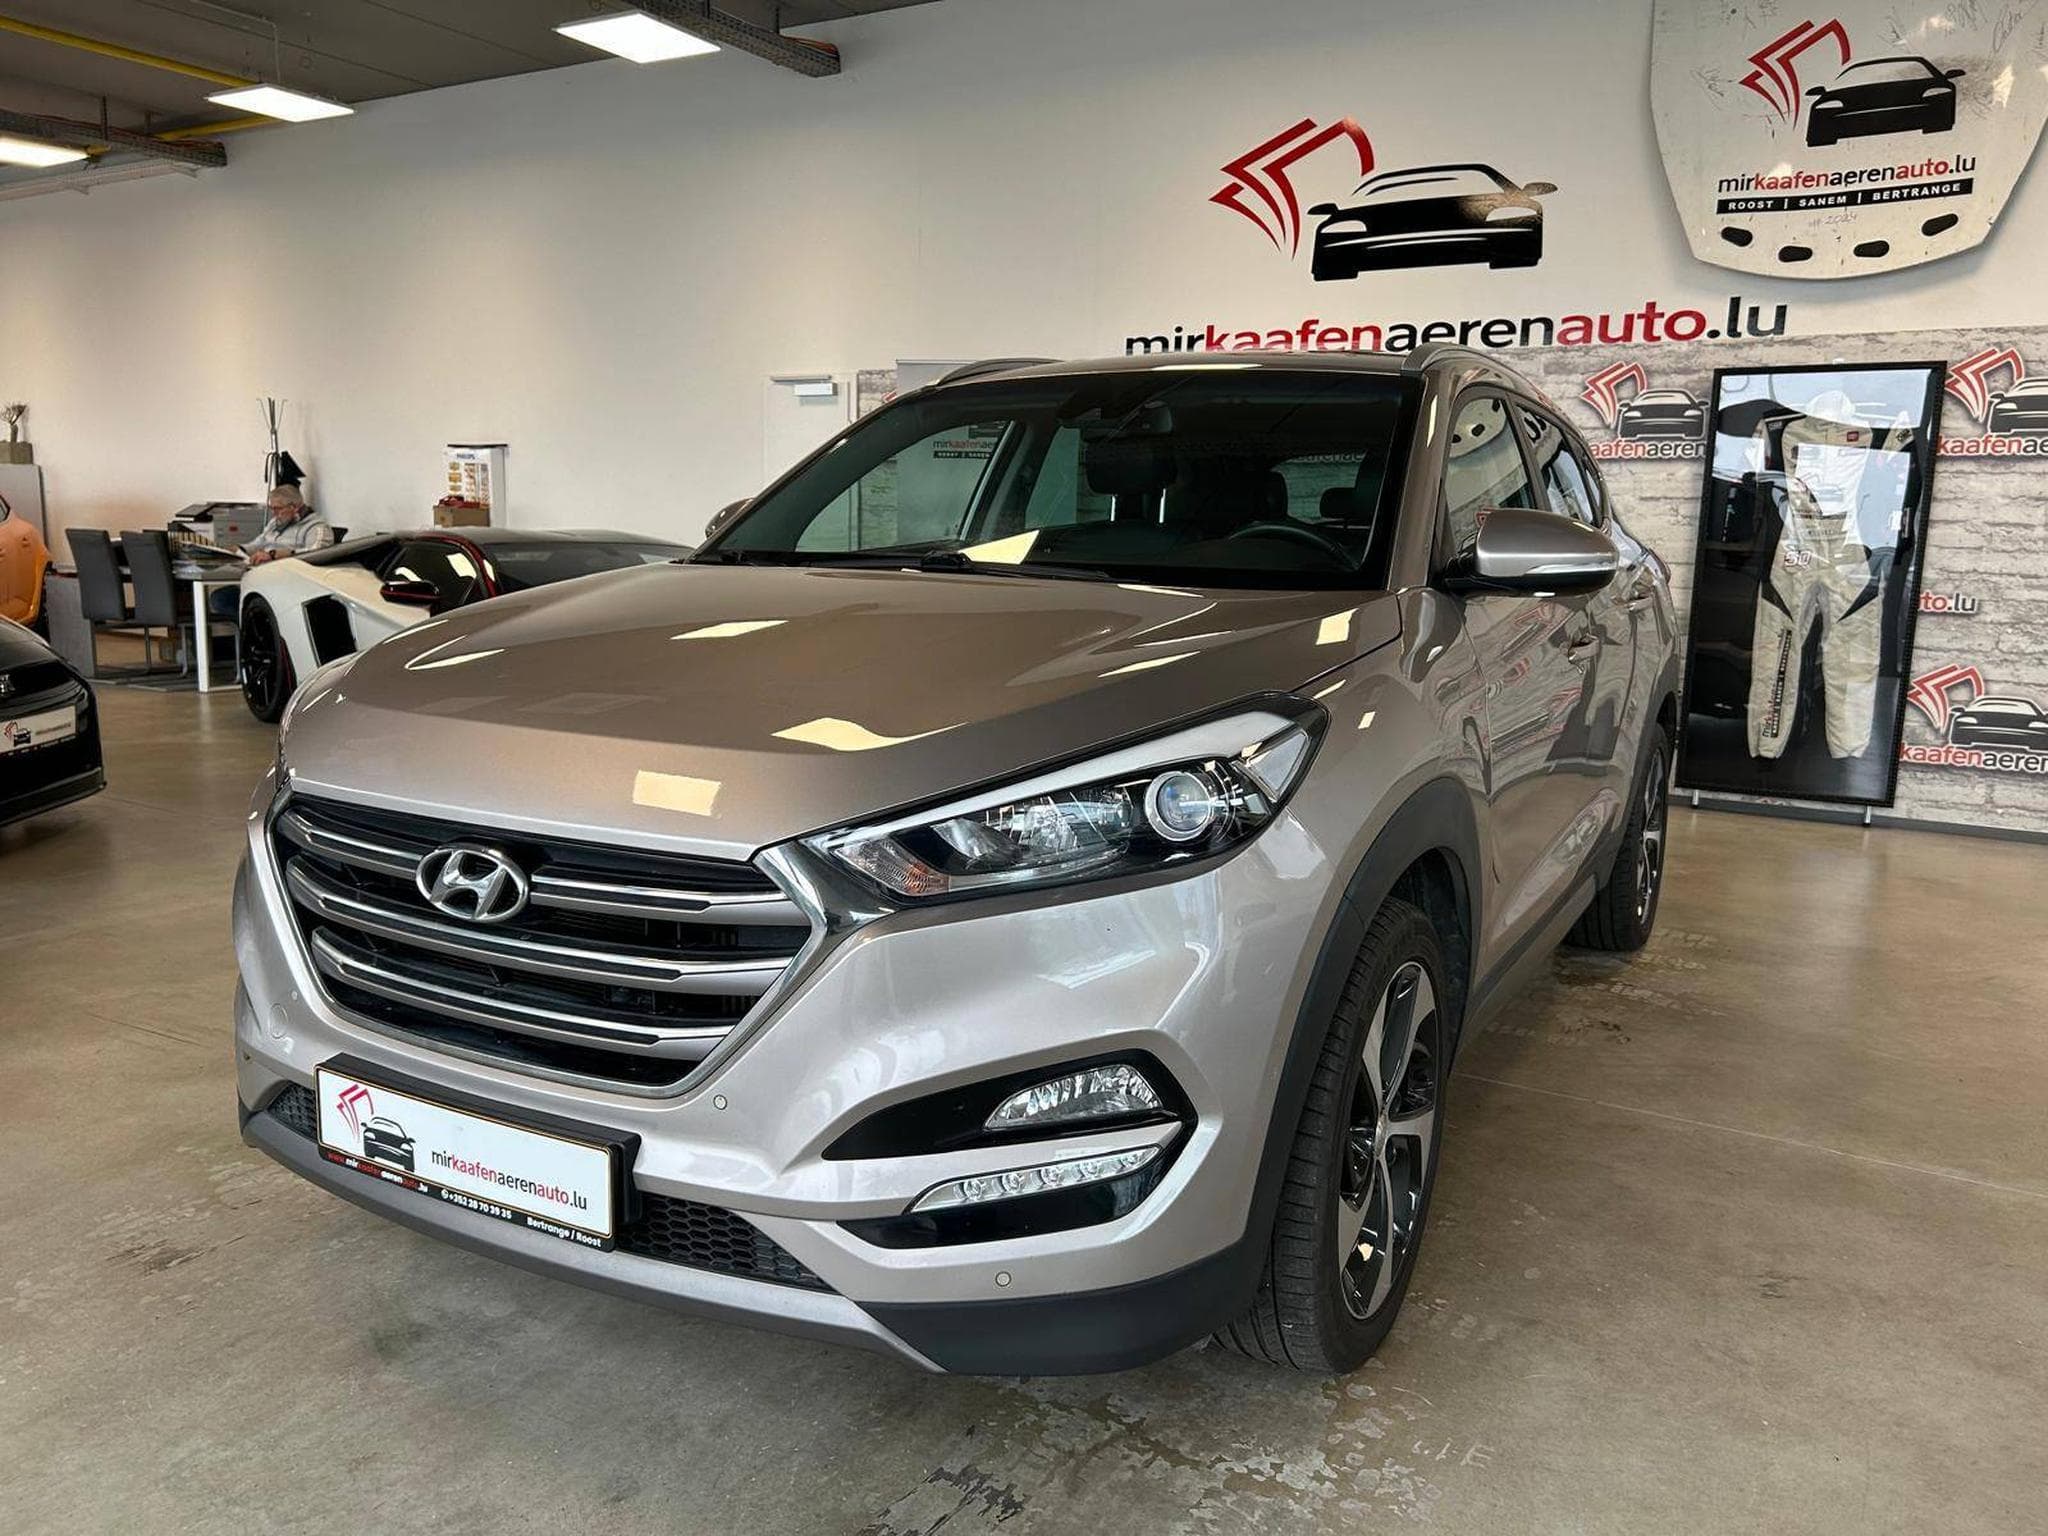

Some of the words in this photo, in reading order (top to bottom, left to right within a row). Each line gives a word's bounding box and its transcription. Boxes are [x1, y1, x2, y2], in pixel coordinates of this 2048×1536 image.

[1718, 154, 1976, 193] mirkaafenaerenauto.lu
[1728, 201, 1775, 211] ROOST
[1799, 195, 1847, 207] SANEM
[1872, 183, 1961, 201] BERTRANGE
[1126, 296, 1788, 353] mirkaafenaerenauto.lu
[431, 1149, 588, 1211] mirkaafenaerenauto.lu
[576, 1232, 602, 1248] Roost
